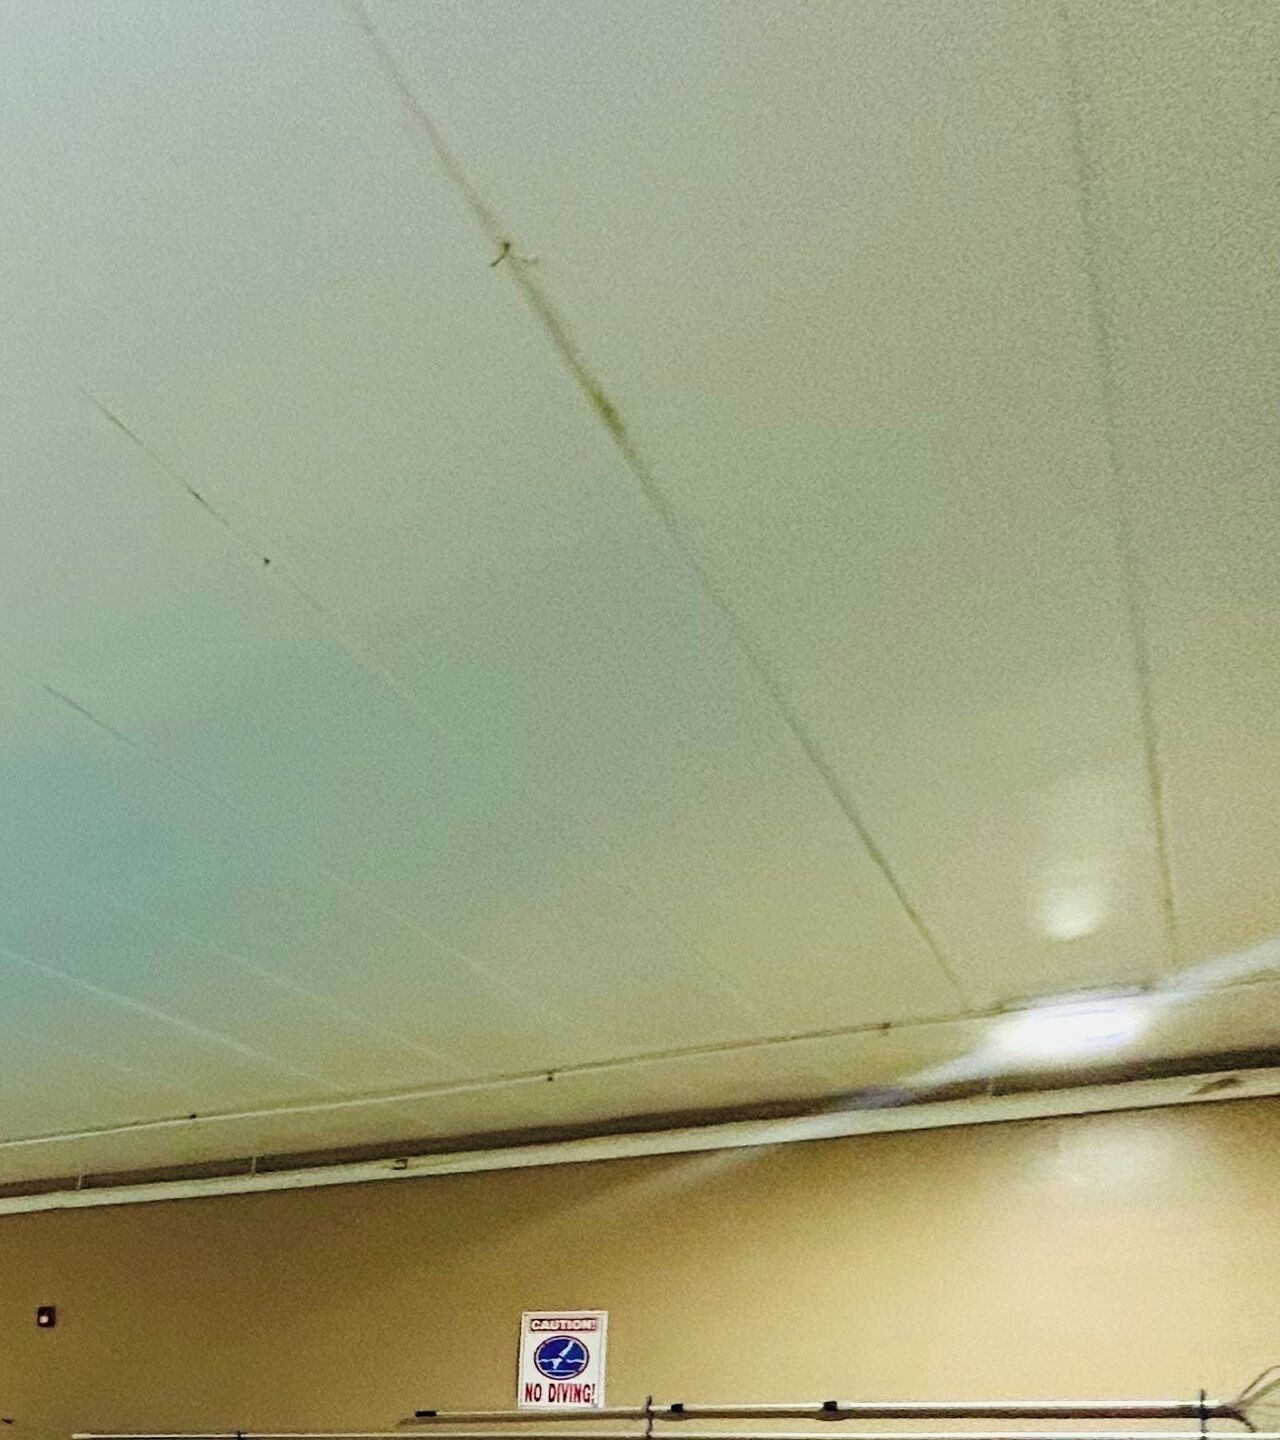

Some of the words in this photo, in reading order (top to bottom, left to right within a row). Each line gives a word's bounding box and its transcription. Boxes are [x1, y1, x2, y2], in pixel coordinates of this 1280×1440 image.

[530, 1318, 598, 1331] CAUTION!
[525, 1383, 542, 1403] NO
[548, 1383, 596, 1404] DIVING!
